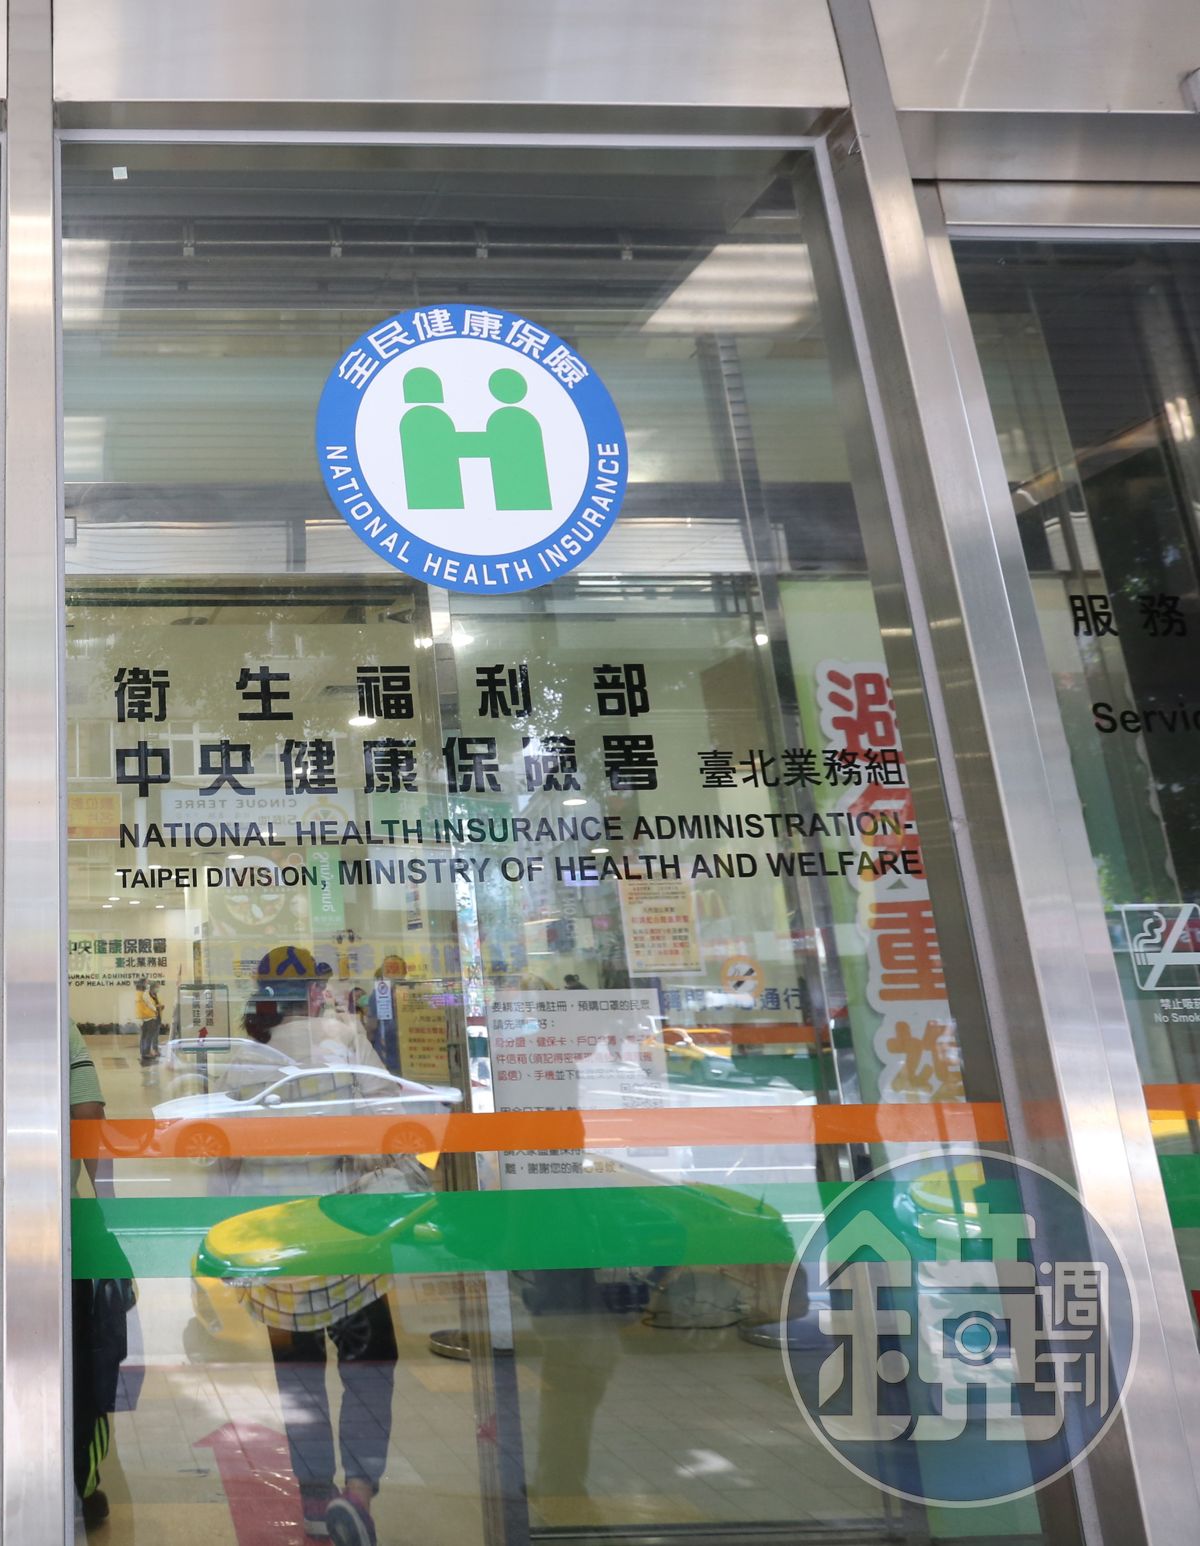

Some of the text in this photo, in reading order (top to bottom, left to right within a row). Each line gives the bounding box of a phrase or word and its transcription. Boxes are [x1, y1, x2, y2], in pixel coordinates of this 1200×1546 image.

[338, 308, 588, 390] 全民健康保險
[325, 442, 620, 585] NATIONAL HEALTH INSURANCE
[115, 664, 650, 723] 衛生福利部
[115, 735, 905, 797] 中央健康保險署 臺北業務組
[119, 811, 914, 848] NATIONAL HEALTH INSURANCE ADMINISTRATION-
[116, 850, 925, 890] TAIPEI DIVISION, MINISTRY OF HEALTH AND WELFARE
